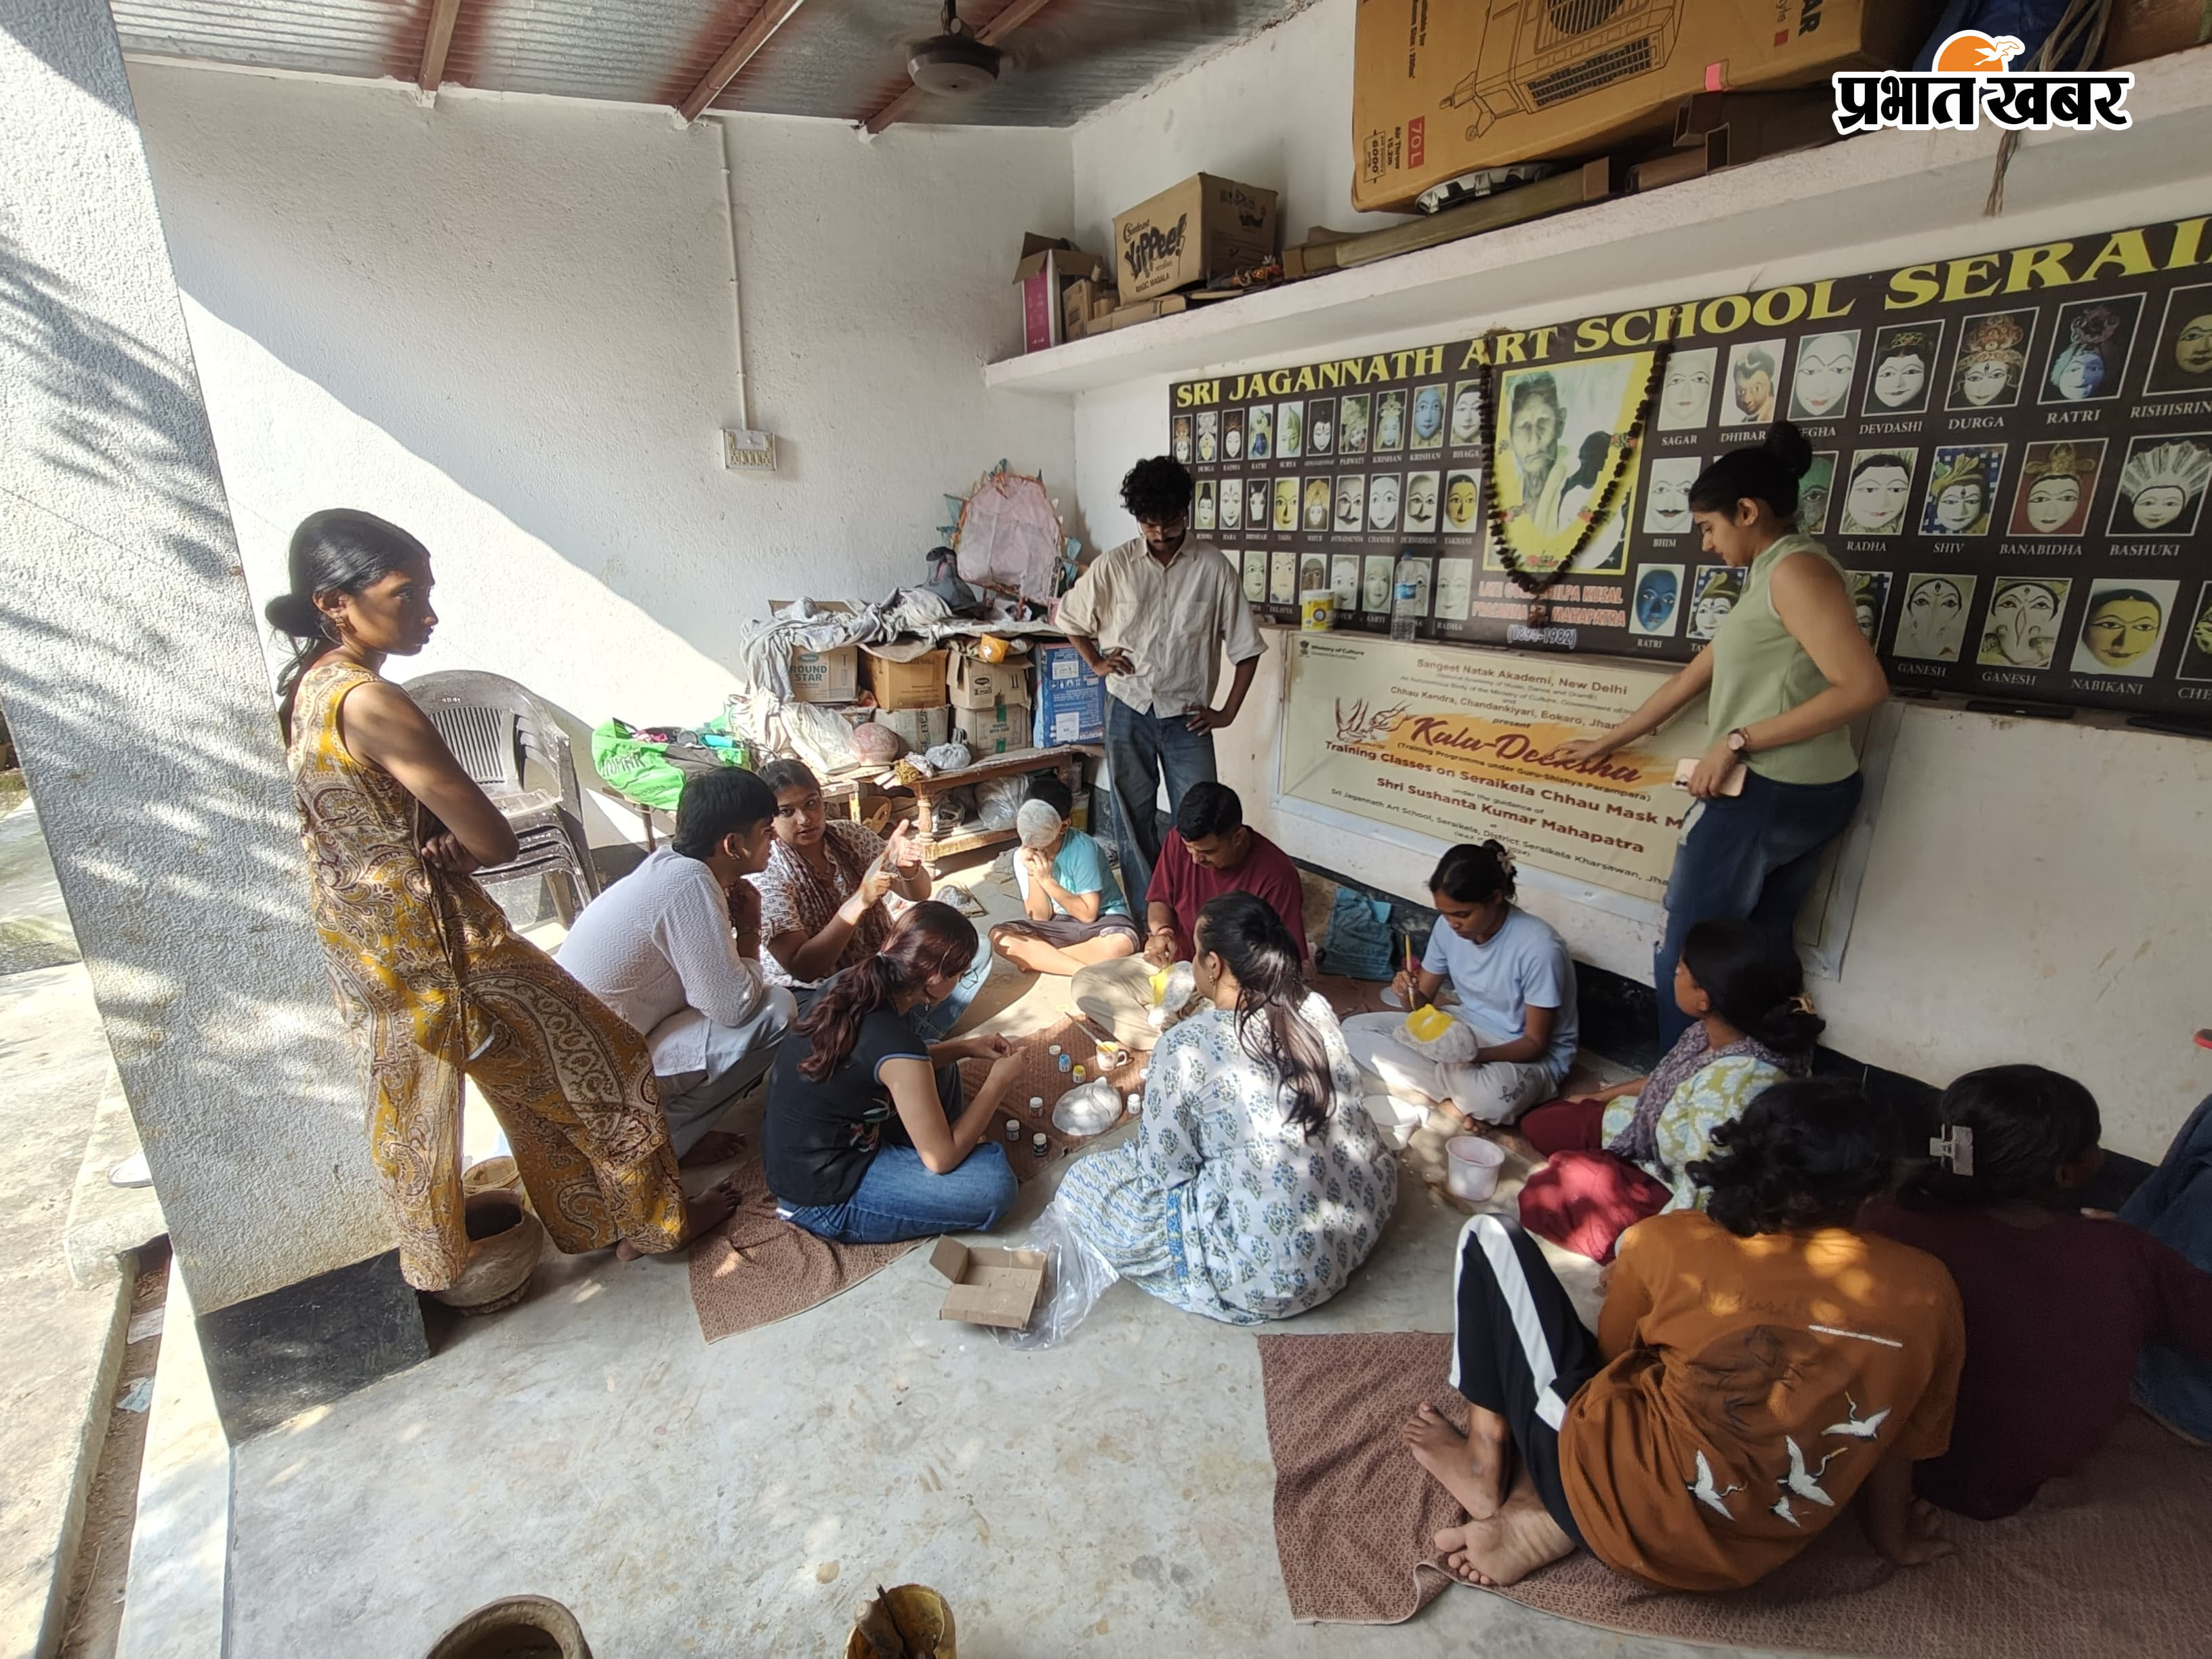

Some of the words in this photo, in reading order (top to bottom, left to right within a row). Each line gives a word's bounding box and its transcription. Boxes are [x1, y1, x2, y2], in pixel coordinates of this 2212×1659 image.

[1176, 380, 1220, 408] SRI
[1227, 344, 1446, 401] JAGANNATH
[1459, 327, 1559, 371] ART
[1574, 279, 1857, 354] SCHOOL
[1885, 216, 2212, 310] SERAI
[1947, 416, 2005, 431] DURGA
[2046, 409, 2102, 424] RATRI
[1799, 426, 1837, 438] EGHA
[1859, 421, 1923, 436] DEVDASHI
[1661, 434, 1698, 447] SAGAR
[1720, 430, 1766, 443] DHIBAR
[1372, 454, 1402, 464] KRISHAN
[1410, 452, 1441, 462] KRISHAN
[1653, 539, 1677, 548] BHIM
[1846, 541, 1887, 552] RADHA
[1933, 543, 1965, 554] SHIV
[1999, 544, 2083, 556] BANABIDHA
[2109, 544, 2181, 556] BASHUKI
[1582, 586, 1624, 605] KUSAL
[1550, 606, 1626, 628] MAHAPATRA
[1637, 638, 1663, 649] RATRI
[790, 665, 827, 674] ROUND
[1416, 658, 1460, 674] Sangeet
[1462, 665, 1495, 678] Natak
[1496, 669, 1555, 687] Akademi,
[1558, 677, 1588, 689] New
[1591, 682, 1628, 695] Delhi
[1898, 663, 1947, 677] GANESH
[795, 673, 823, 682] STAR
[1982, 671, 2036, 686] GANESH
[2071, 678, 2144, 695] NABIKANI
[1391, 686, 1419, 698] Chhau
[1420, 691, 1458, 705] Kendra,
[1459, 697, 1538, 718] Chandankiyari,
[1589, 718, 1618, 731] Jhar
[1492, 717, 1531, 729] present
[1397, 742, 1433, 756] (Training
[1435, 750, 1486, 766] Programme
[1487, 762, 1515, 773] under
[1517, 766, 1584, 789] Guru-Shishya
[1585, 781, 1652, 802] Parampara)
[1325, 741, 1378, 761] Training
[1380, 752, 1433, 773] Classes
[1435, 766, 1456, 777] on
[1459, 771, 1535, 796] Seraikela
[1540, 789, 1600, 811] Chhau
[1605, 803, 1658, 825] Mask
[1376, 777, 1404, 792] Shri
[1407, 784, 1477, 811] Sushanta
[1481, 803, 1538, 826] Kumar
[1541, 818, 1645, 853] Mahapatra
[1344, 791, 1385, 808] Jagannath
[1386, 803, 1400, 812] Art
[1401, 807, 1435, 823] School,
[1436, 817, 1481, 836] Seraikela,
[1483, 830, 1519, 846] District
[1522, 840, 1572, 861] Seraikela
[1574, 855, 1643, 881] Kharsawan,
